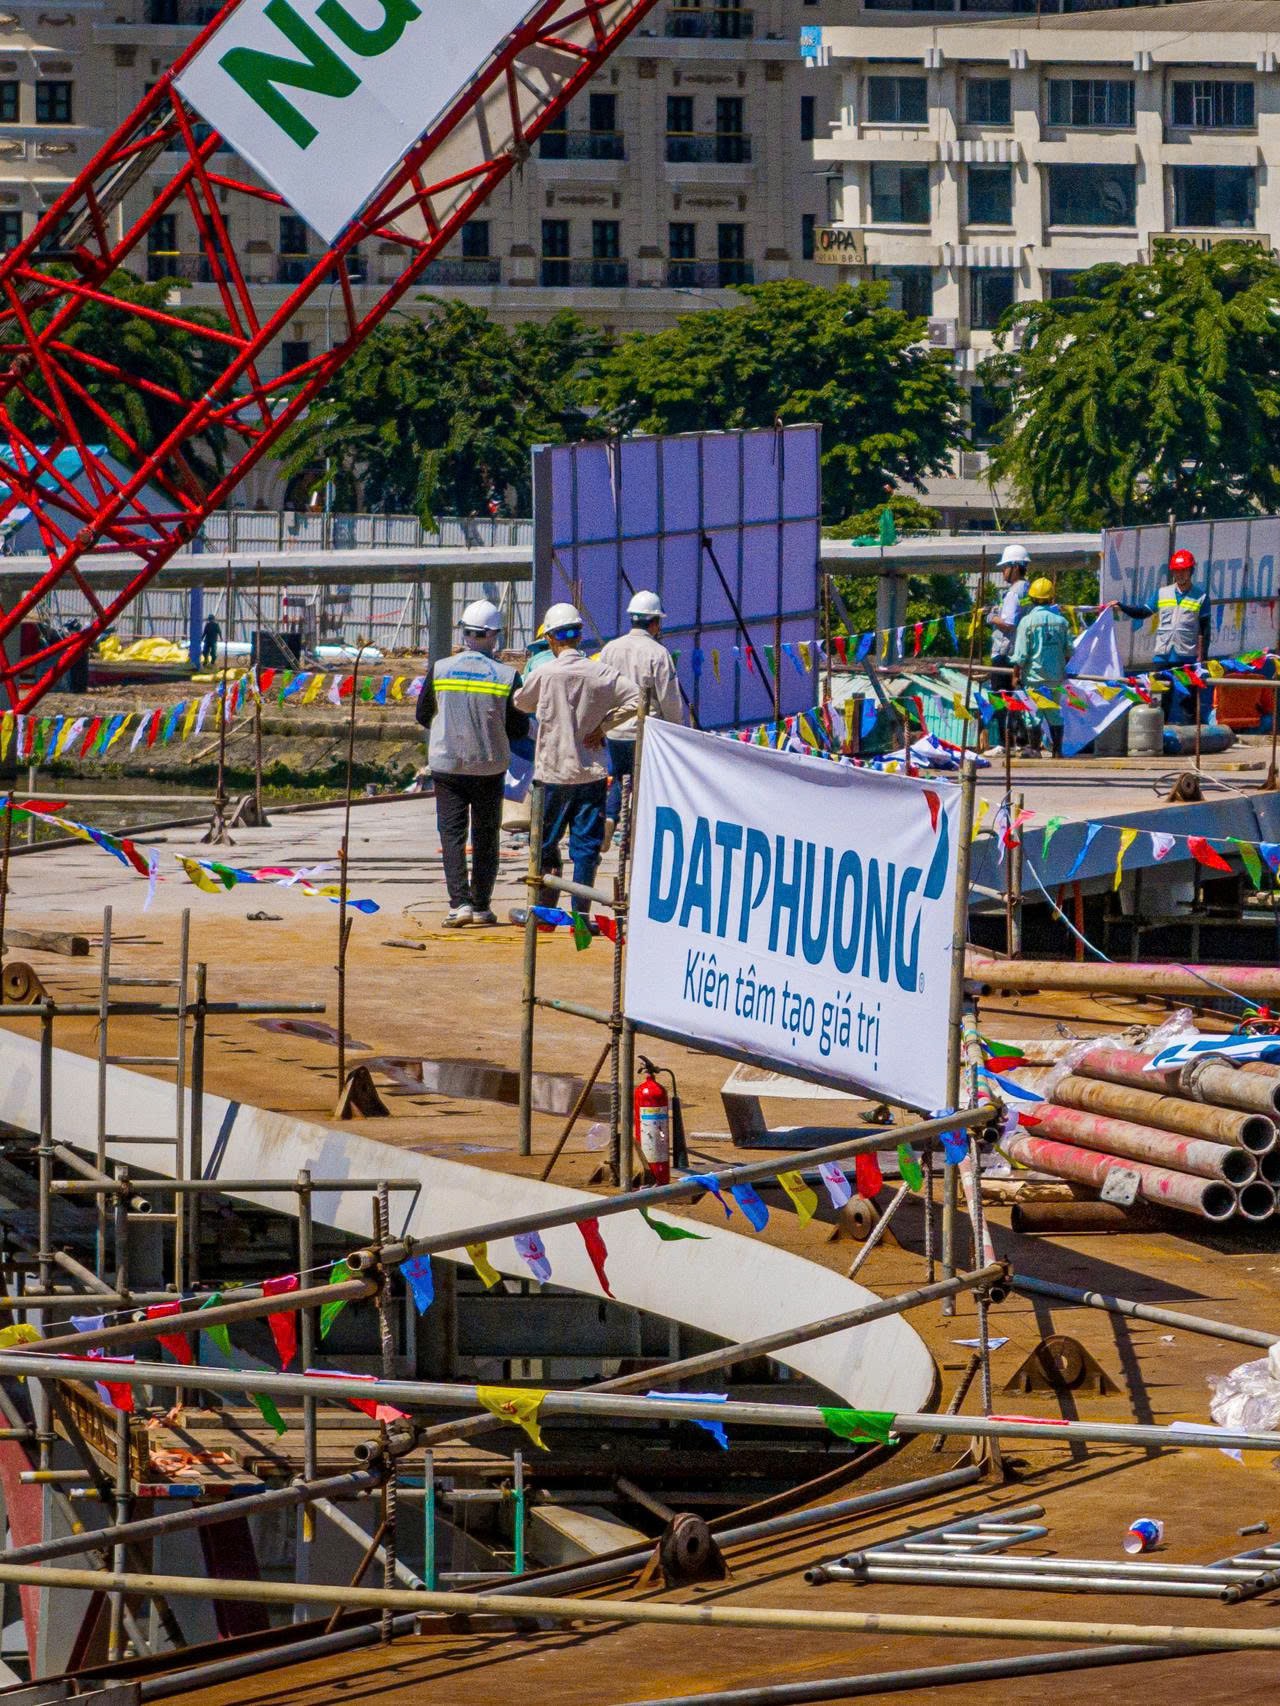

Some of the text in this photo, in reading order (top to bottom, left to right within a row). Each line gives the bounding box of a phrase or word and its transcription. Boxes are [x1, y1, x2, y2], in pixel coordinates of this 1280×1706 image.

[821, 230, 856, 251] OPPA
[648, 805, 923, 993] DATPHUONG
[683, 949, 882, 1072] Kiên tâm tạo giá trị
